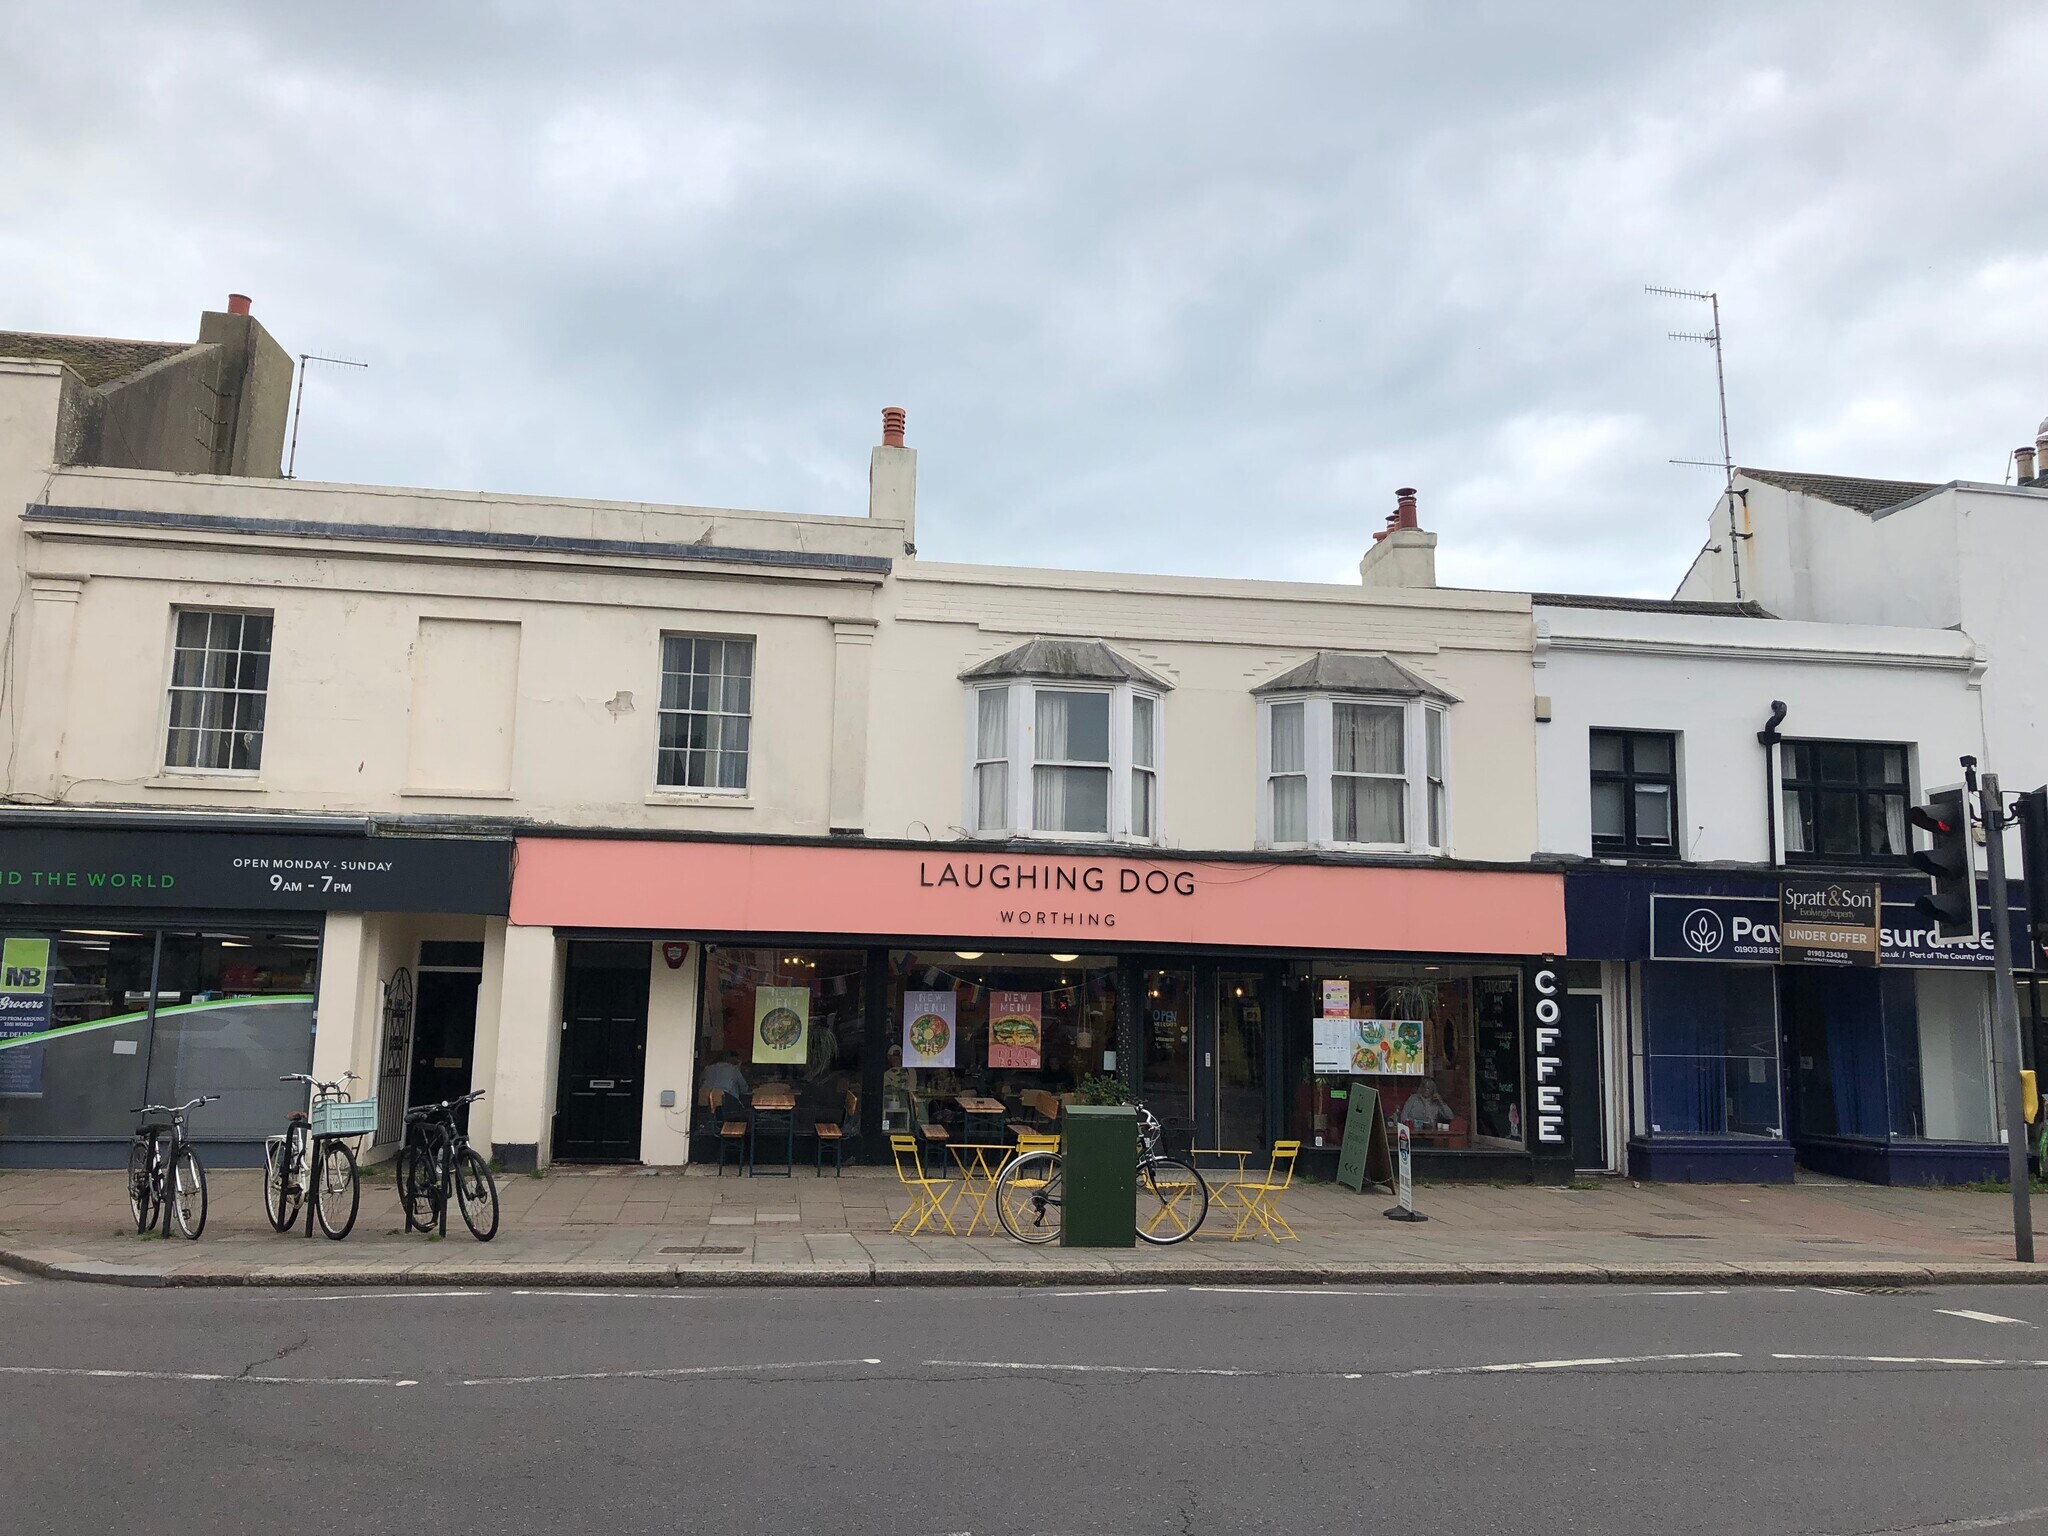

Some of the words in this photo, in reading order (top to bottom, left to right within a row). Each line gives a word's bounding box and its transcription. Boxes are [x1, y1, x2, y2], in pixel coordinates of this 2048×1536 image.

[233, 858, 269, 868] OPEN
[273, 859, 330, 869] MONDAY
[340, 861, 393, 871] SUNDAY
[0, 872, 22, 885] D
[32, 872, 77, 886] THE
[88, 873, 175, 888] WORLD
[269, 874, 302, 892] 9AM
[321, 876, 352, 893] 7PM
[920, 862, 1104, 892] LAUGHING
[1120, 868, 1195, 896] DOG
[1785, 888, 1827, 910] Spratt
[1842, 889, 1872, 908] Son
[1000, 911, 1116, 927] WORTHING
[1789, 929, 1827, 941] UNDER
[1829, 932, 1867, 944] OFFER
[1826, 951, 1848, 959] 234343
[1910, 951, 1926, 959] Part
[1950, 953, 1976, 961] County
[5, 966, 41, 987] MB
[0, 996, 43, 1010] Grocers
[918, 993, 942, 1002] NEW
[1004, 993, 1028, 1002] NEW
[914, 1003, 946, 1012] MENU
[1000, 1003, 1031, 1012] MENU
[1535, 970, 1564, 1142] COFFEE
